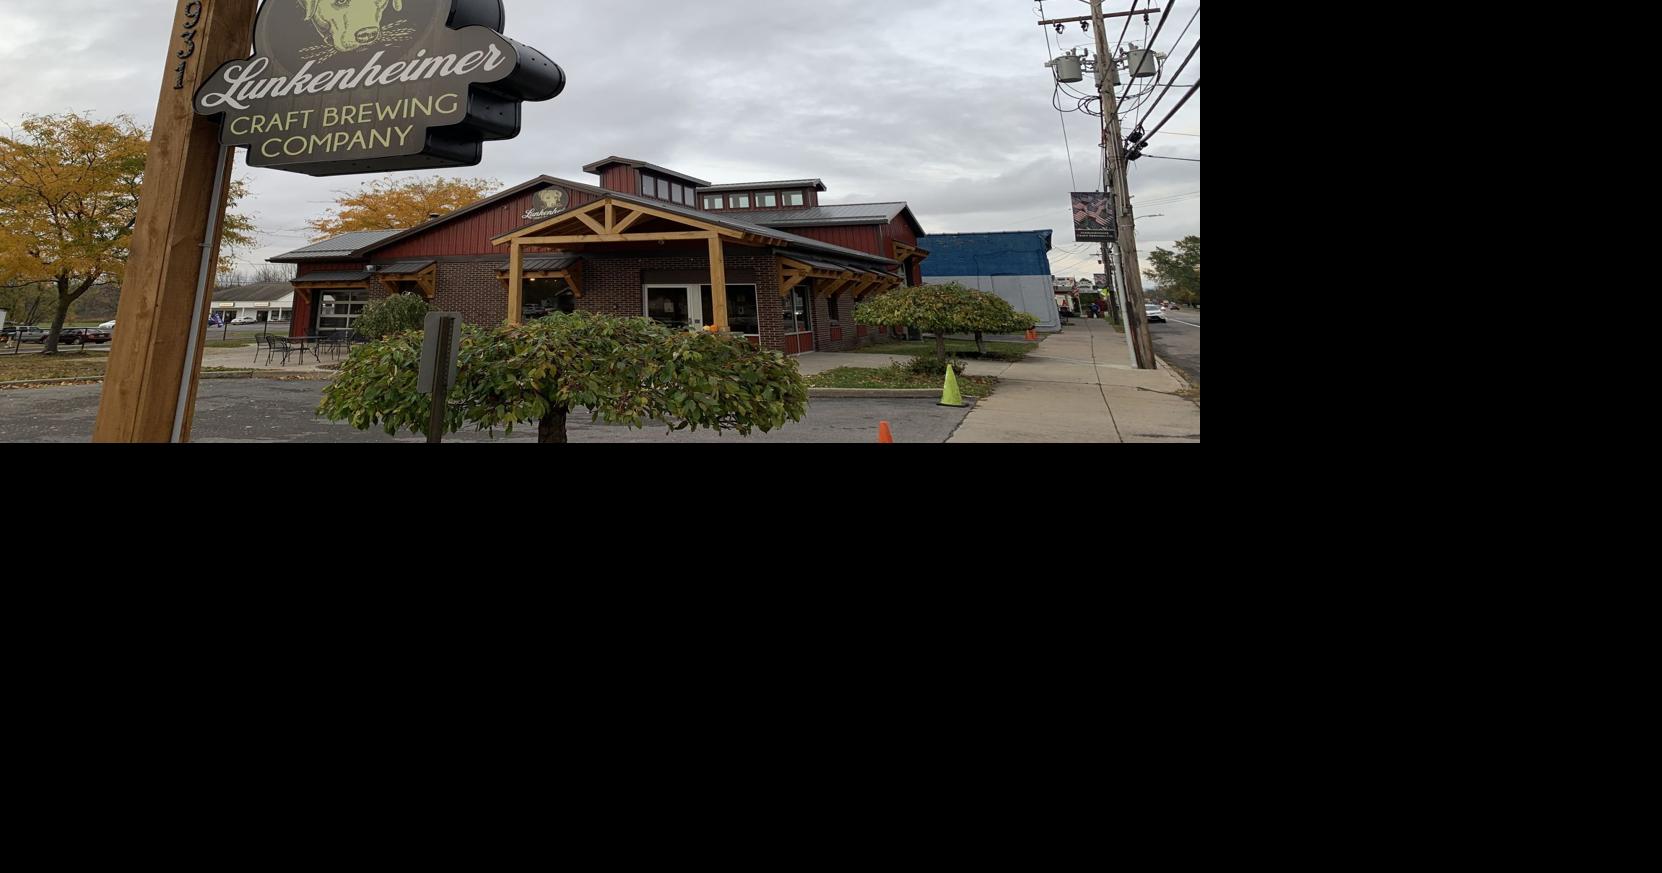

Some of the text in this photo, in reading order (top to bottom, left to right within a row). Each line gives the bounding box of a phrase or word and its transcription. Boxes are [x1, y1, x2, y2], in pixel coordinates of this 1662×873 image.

[201, 44, 507, 109] Lunkenheimer
[230, 93, 458, 136] CRAFT BREWING
[261, 125, 414, 158] COMPANY
